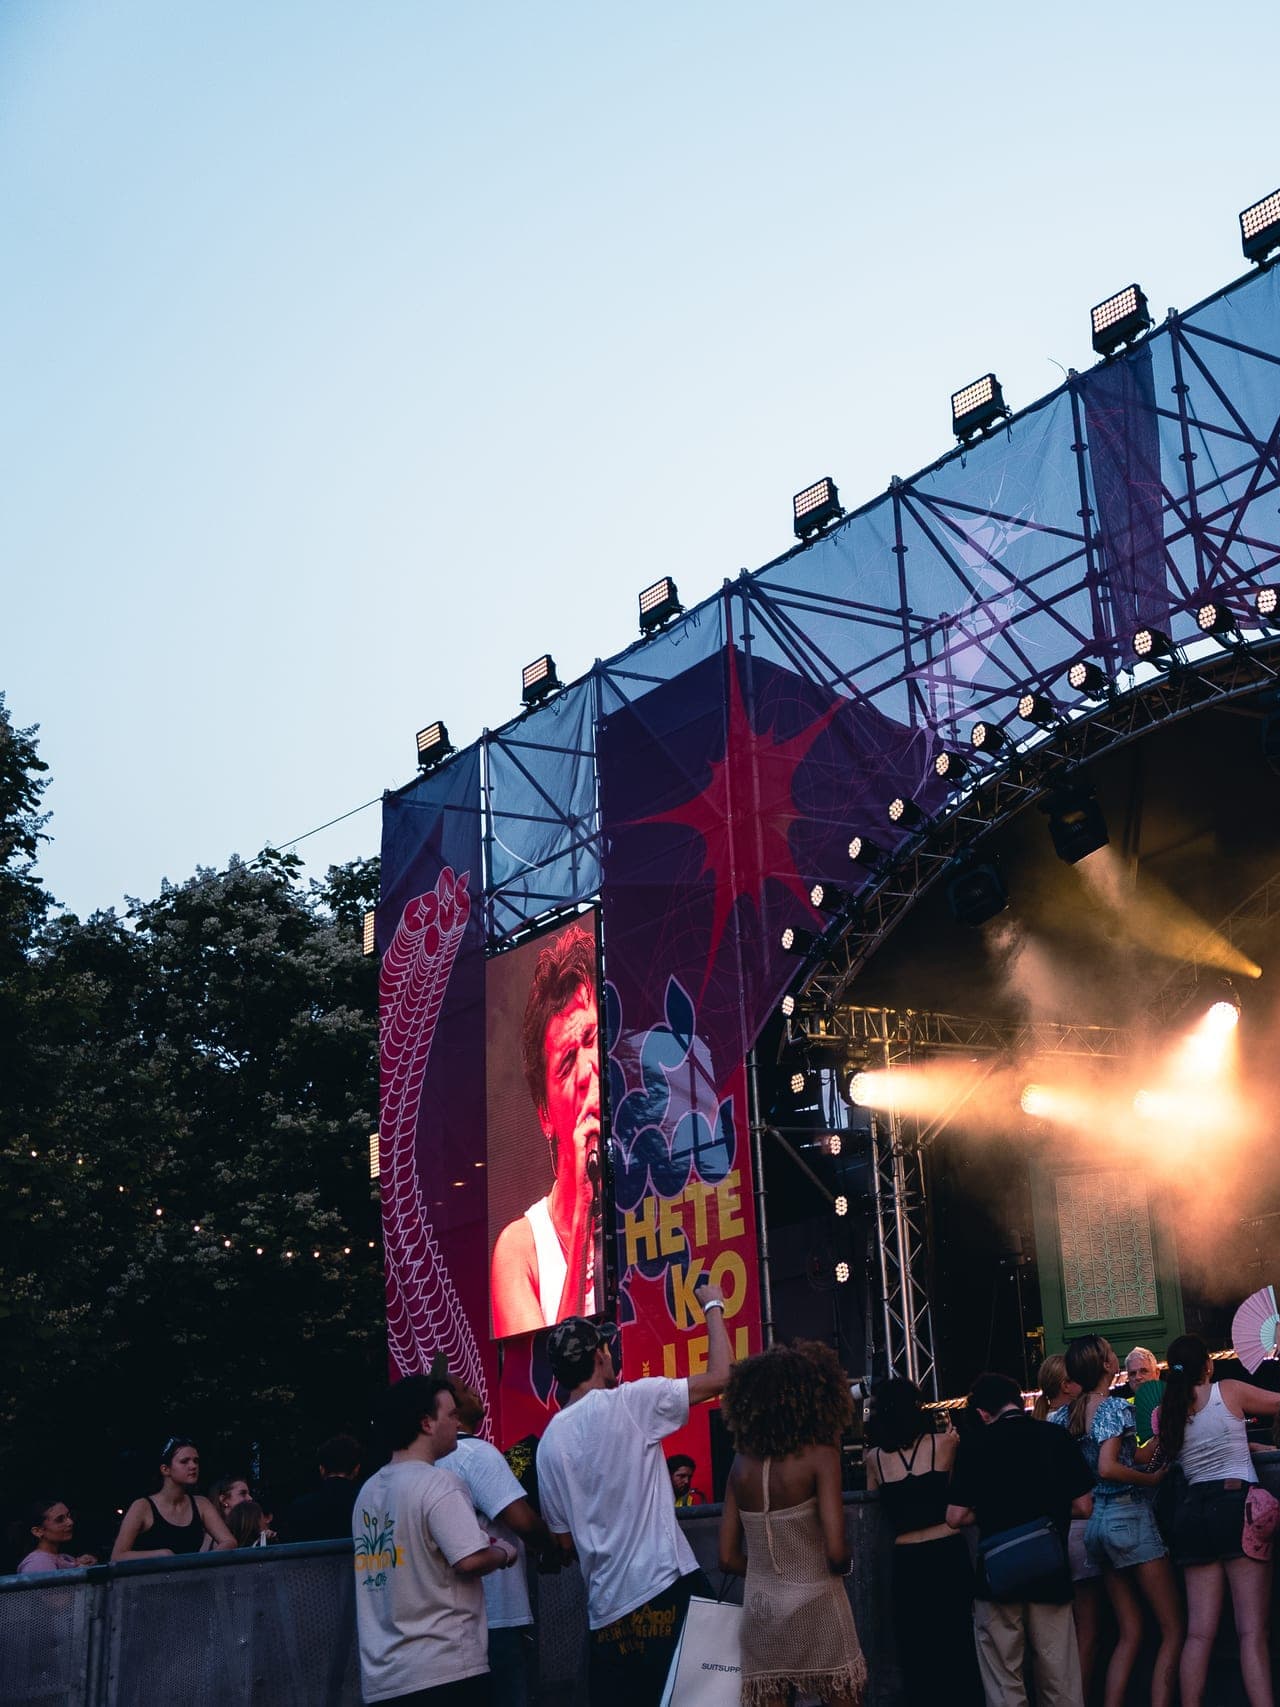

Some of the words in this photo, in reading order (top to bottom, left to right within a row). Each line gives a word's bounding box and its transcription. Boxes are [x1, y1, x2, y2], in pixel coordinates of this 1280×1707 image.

[624, 1168, 745, 1266] HETE
[670, 1250, 748, 1330] KO
[701, 1662, 744, 1673] SUITSUPP
